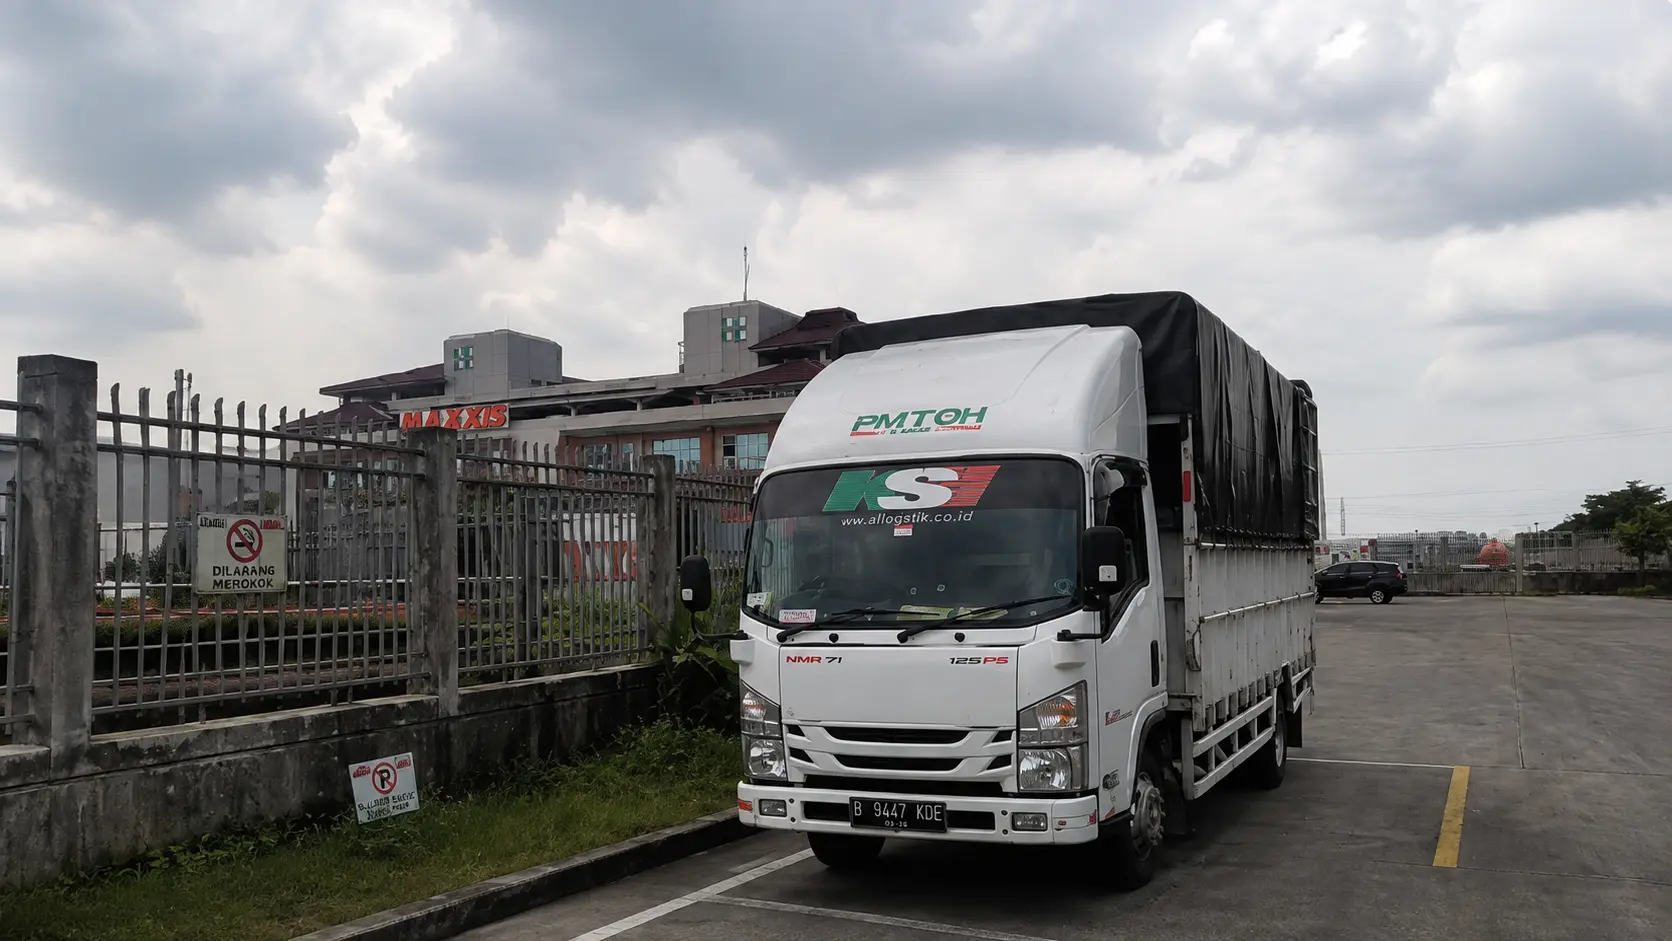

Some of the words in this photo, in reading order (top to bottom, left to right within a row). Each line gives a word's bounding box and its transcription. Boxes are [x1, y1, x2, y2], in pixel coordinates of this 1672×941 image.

[401, 405, 507, 432] MAXXIS
[852, 406, 988, 432] PMTOH
[212, 565, 275, 577] DILARANG
[212, 578, 274, 590] MEROKOK
[825, 656, 842, 664] 71
[854, 801, 862, 816] B
[873, 801, 906, 819] 9447
[916, 804, 942, 821] KDE
